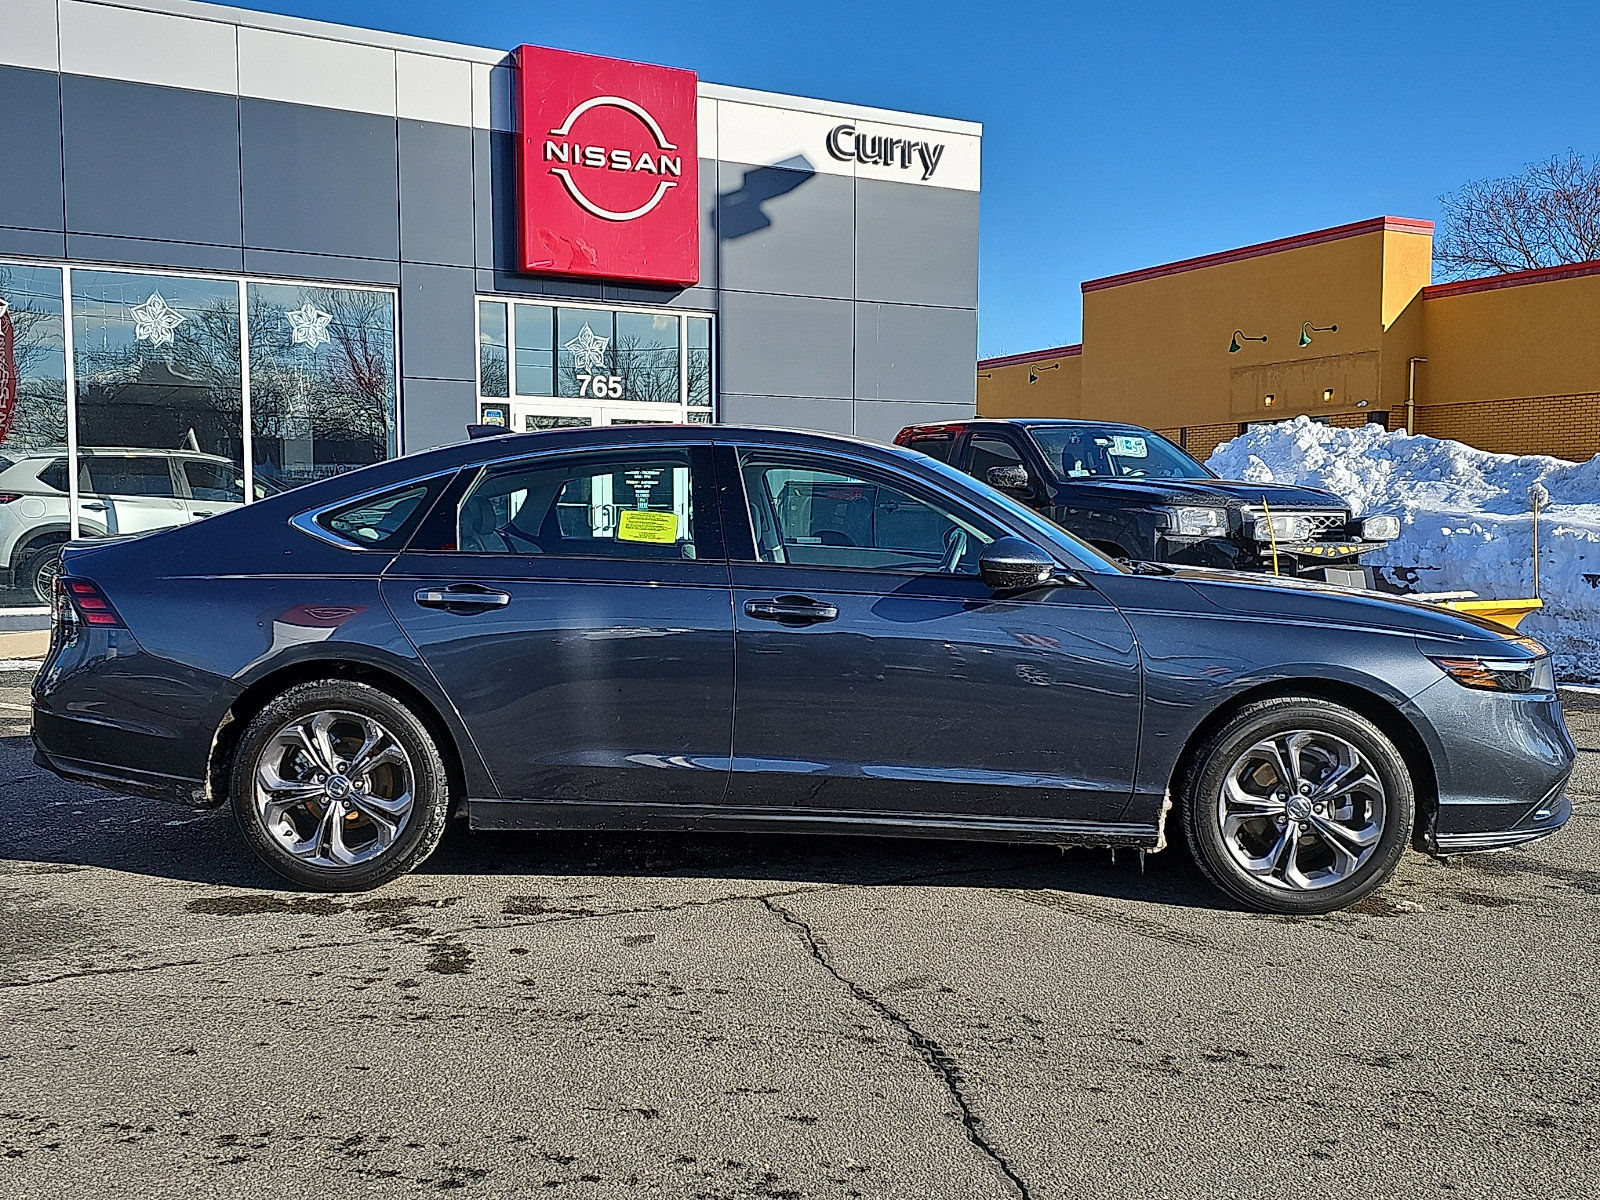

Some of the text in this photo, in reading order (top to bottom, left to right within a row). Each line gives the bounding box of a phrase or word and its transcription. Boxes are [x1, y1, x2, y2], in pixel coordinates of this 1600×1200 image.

[545, 140, 682, 176] NISSAN
[828, 124, 945, 179] Curry
[576, 374, 623, 398] 765
